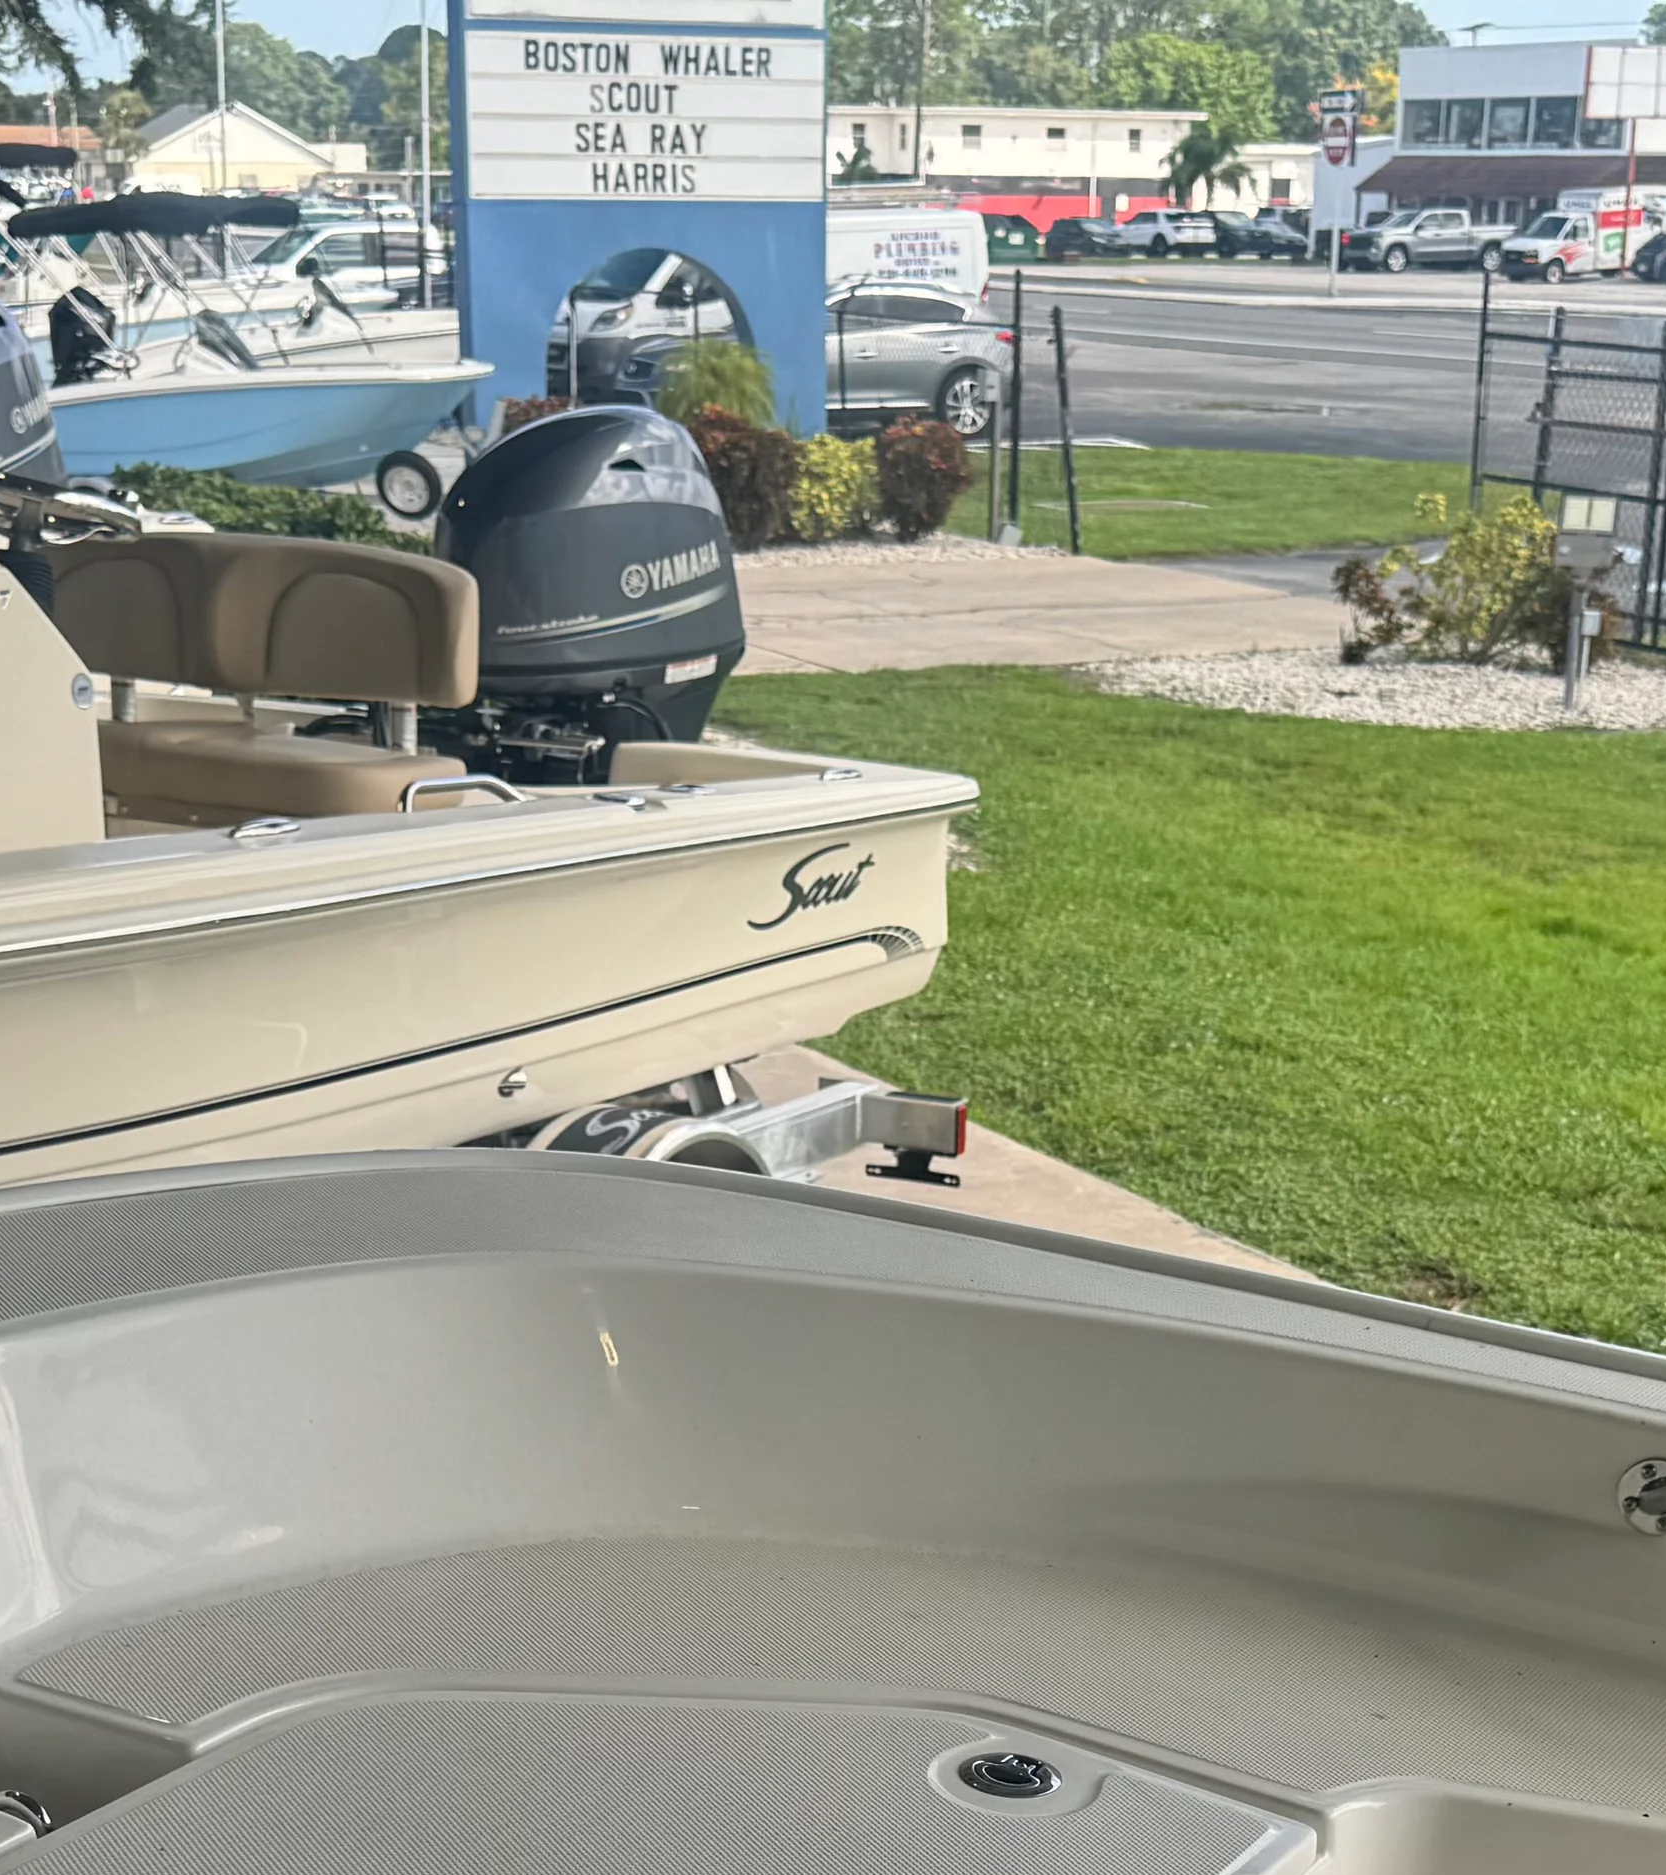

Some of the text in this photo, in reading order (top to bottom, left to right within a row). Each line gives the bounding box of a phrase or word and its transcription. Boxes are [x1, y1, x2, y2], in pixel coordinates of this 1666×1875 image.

[524, 39, 772, 77] BOSTON WHALER
[590, 82, 679, 114] SCOUT
[575, 123, 707, 155] SEA RAY
[592, 163, 696, 193] HARRIS
[647, 540, 721, 592] YAMAHA
[747, 842, 876, 931] Scout
